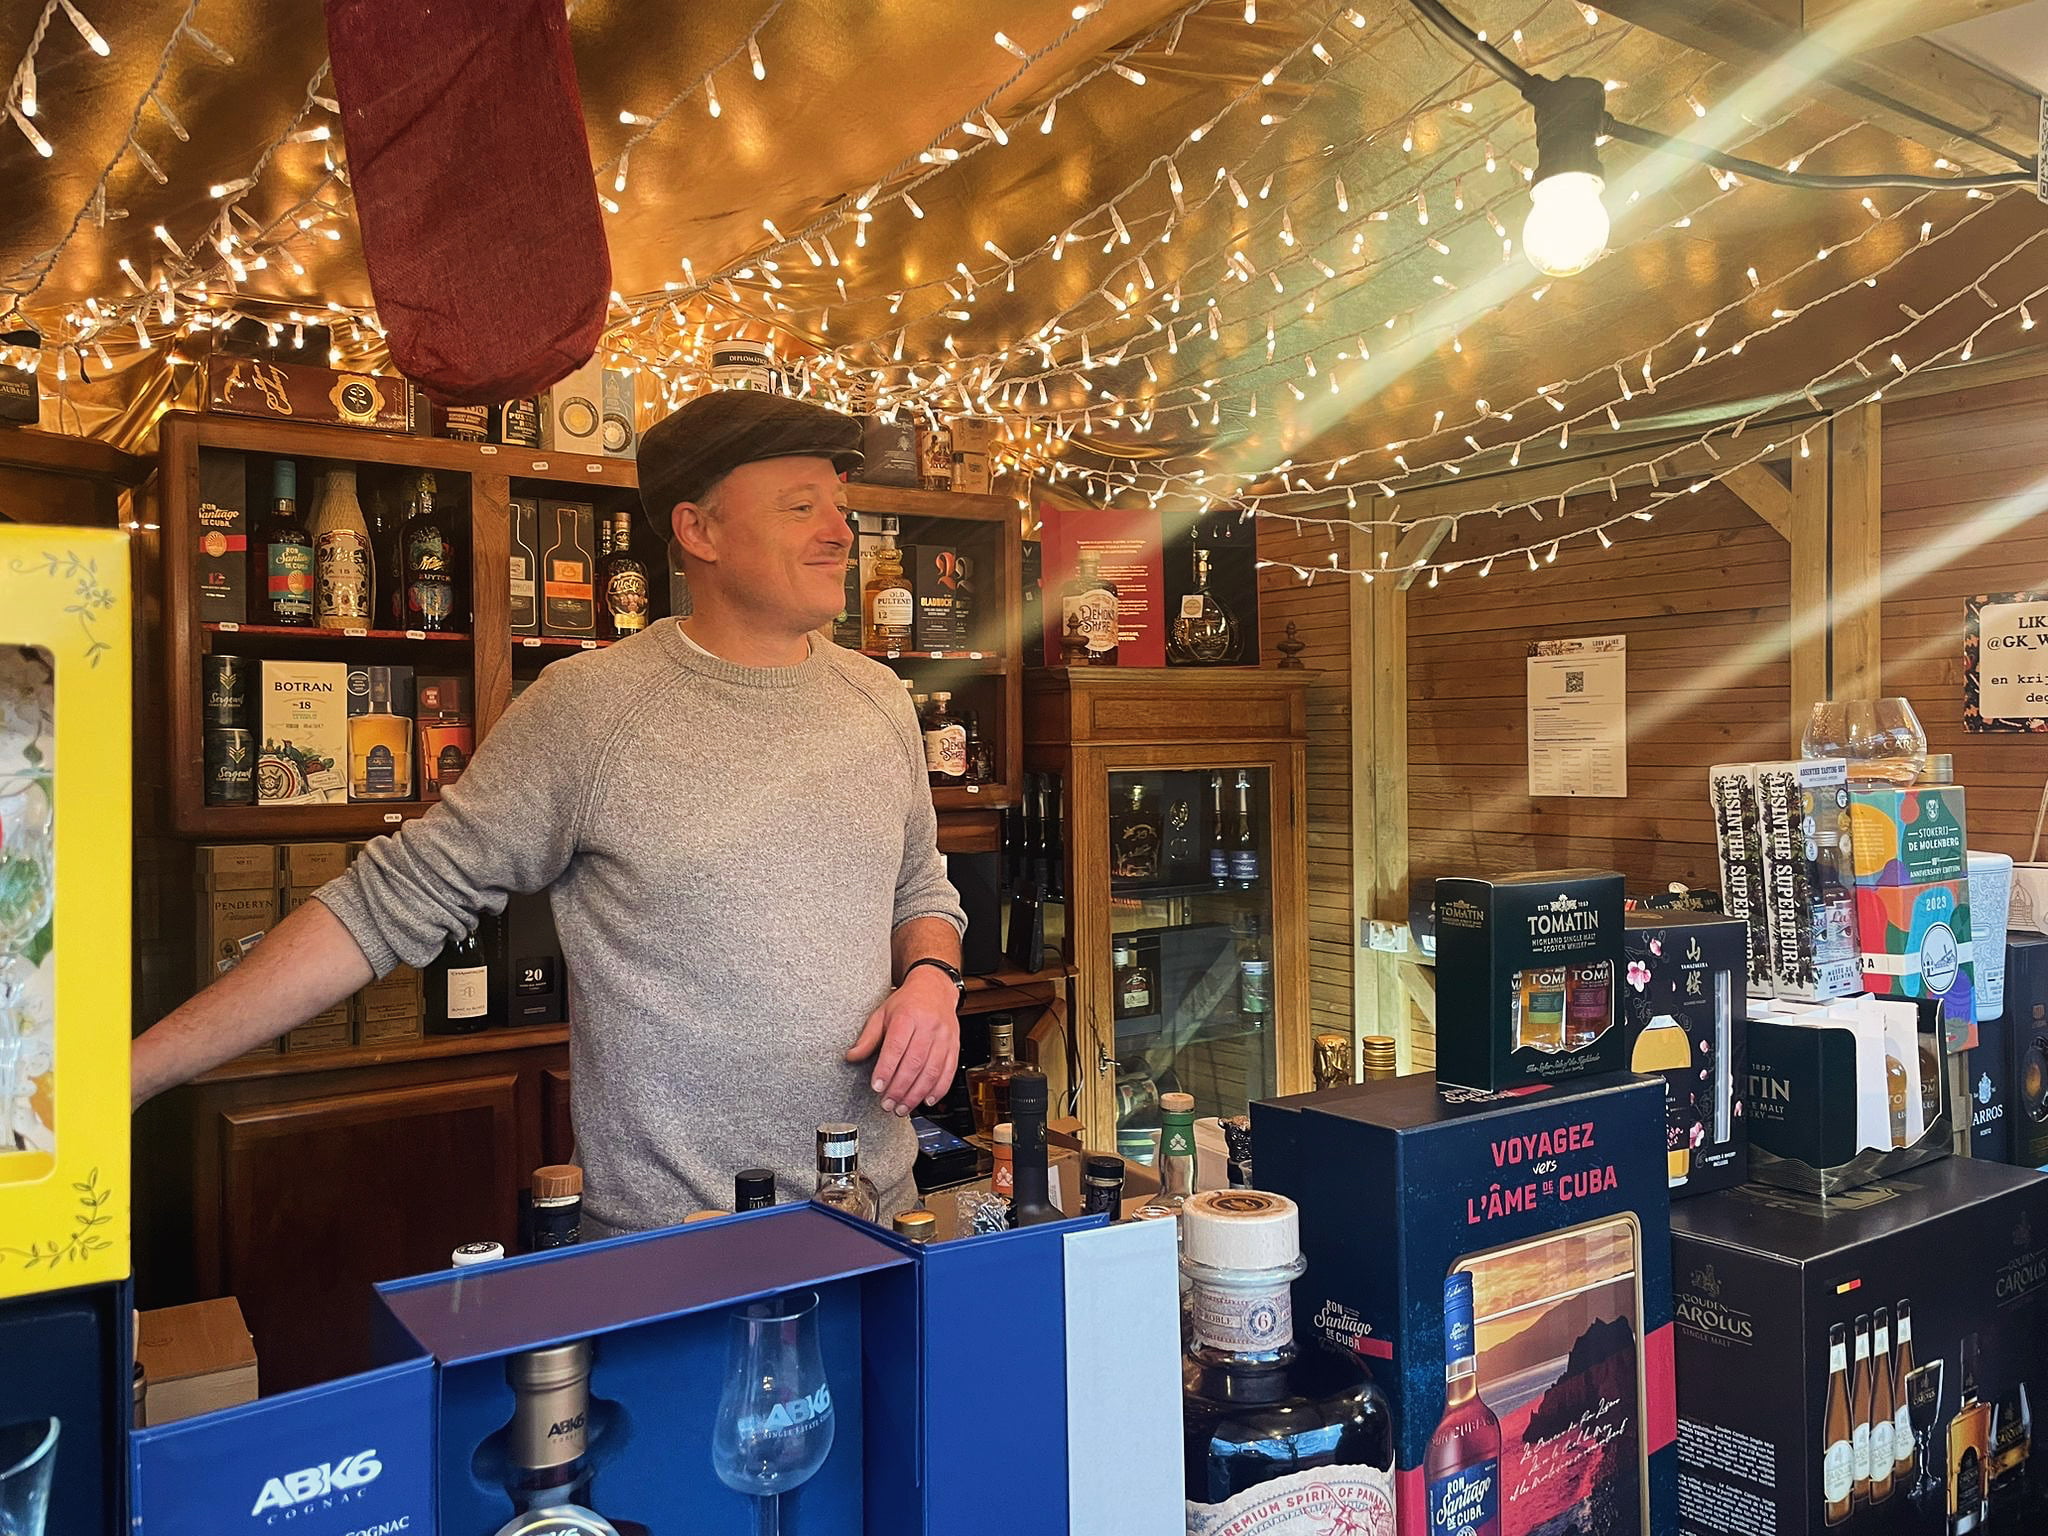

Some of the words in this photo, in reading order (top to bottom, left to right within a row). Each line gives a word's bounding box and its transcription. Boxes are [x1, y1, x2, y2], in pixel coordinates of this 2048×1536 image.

[274, 682, 333, 692] BOTRAN
[299, 701, 312, 709] 18
[1722, 778, 1746, 862] ABSINTHE
[1769, 776, 1792, 861] ABSINTHE
[1918, 826, 1949, 838] STOKERIJ
[1908, 842, 1919, 851] DE
[1919, 837, 1960, 850] MOLENBERG
[1910, 868, 1942, 878] ANNIVERSARY
[214, 900, 274, 911] PENDERYN
[1440, 906, 1484, 921] TOMATIN
[1925, 896, 1947, 911] 2023
[1527, 910, 1599, 935] TOMATIN
[1776, 864, 1801, 979] SUPÉRIEURE
[1531, 937, 1563, 947] HIGHLAND
[1563, 935, 1583, 943] SINGLE
[1583, 933, 1596, 941] MALT
[1543, 944, 1566, 953] SCOTCH
[1686, 937, 1701, 961] 山
[523, 968, 543, 982] 20
[1760, 1103, 1784, 1114] MALT
[1491, 1122, 1595, 1168] VOYAGEZ
[1532, 1159, 1558, 1175] vers
[1467, 1183, 1537, 1225] L'ÂME
[1542, 1180, 1554, 1195] DE
[1559, 1165, 1618, 1201] CUBA
[1326, 1299, 1343, 1315] RON
[1682, 1293, 1728, 1314] GOUDEN
[1257, 1314, 1269, 1330] 6
[1314, 1307, 1373, 1338] Santiago
[1674, 1303, 1753, 1338] AROLUS
[1326, 1328, 1336, 1340] DE
[1336, 1332, 1361, 1351] CUBA
[1681, 1327, 1709, 1342] SINGLE
[1710, 1336, 1731, 1348] MALT
[547, 1412, 585, 1438] ABK6
[251, 1449, 383, 1517] ABK6
[1447, 1476, 1465, 1495] RON
[266, 1488, 367, 1526] COGNAC
[1286, 1489, 1333, 1509] SPIRIT
[1338, 1487, 1353, 1498] OF
[1436, 1476, 1492, 1526] Santiago
[1446, 1514, 1457, 1531] DE
[1456, 1504, 1485, 1526] CUBA.
